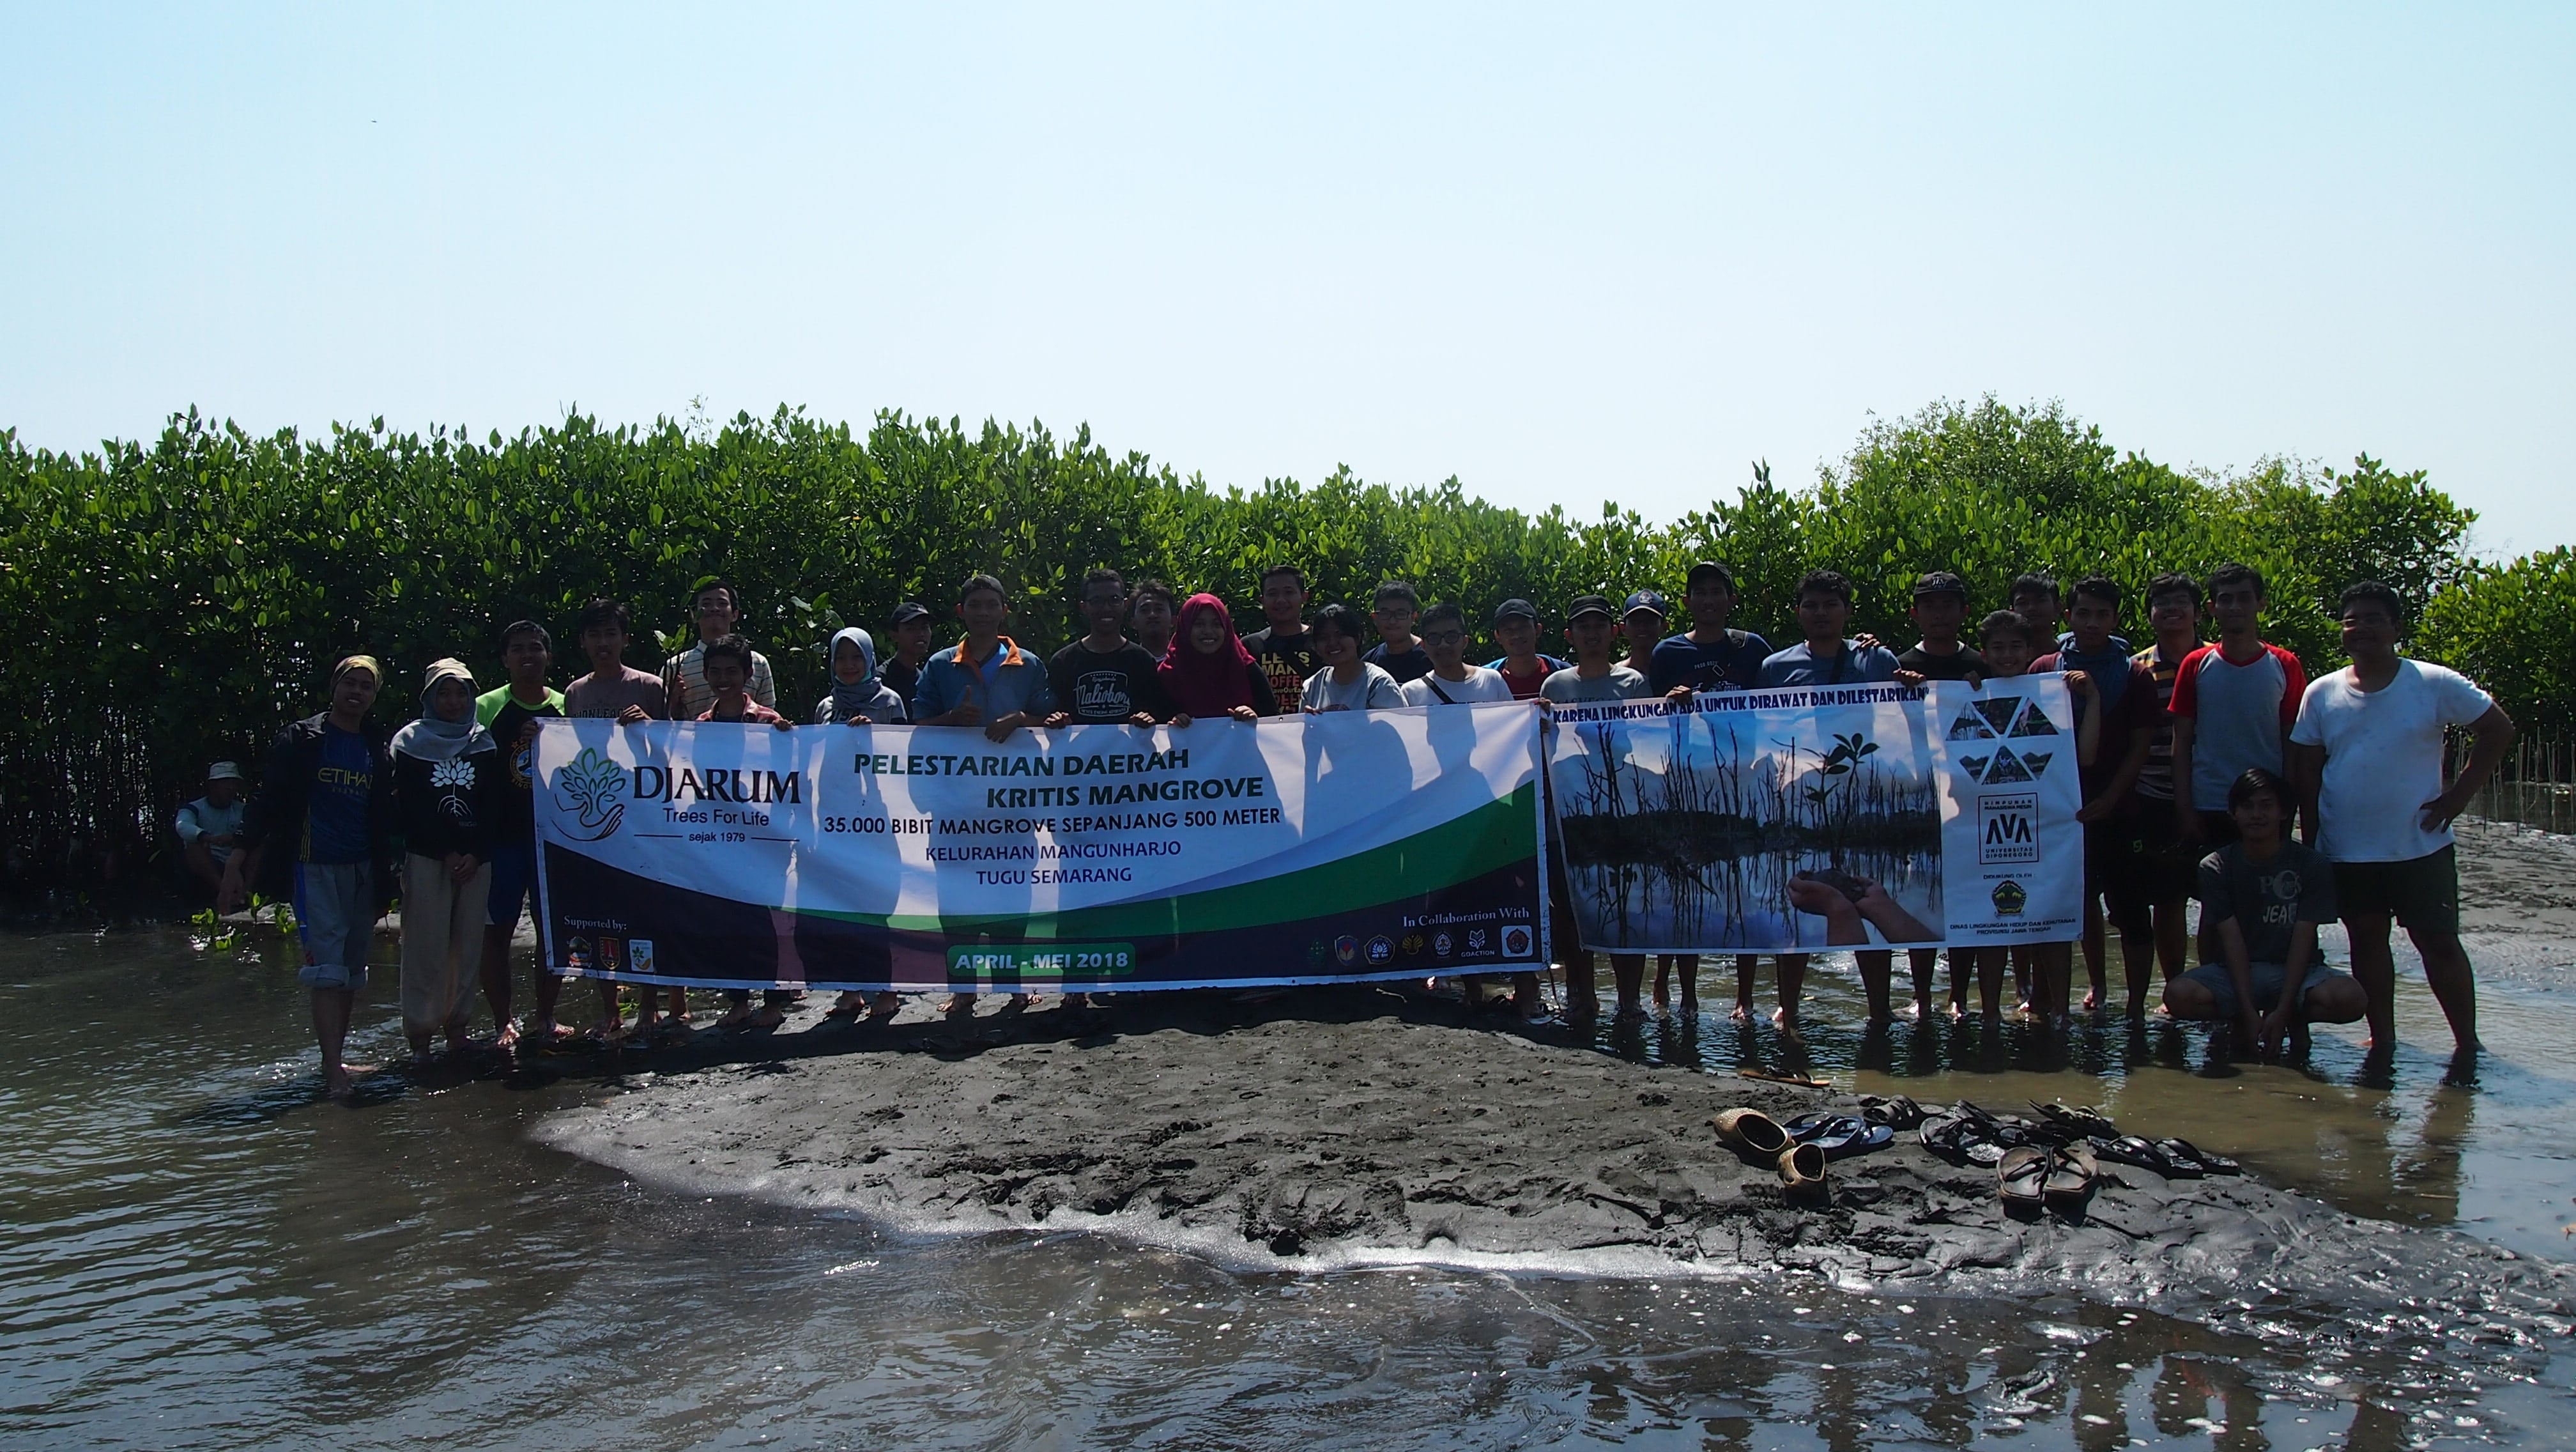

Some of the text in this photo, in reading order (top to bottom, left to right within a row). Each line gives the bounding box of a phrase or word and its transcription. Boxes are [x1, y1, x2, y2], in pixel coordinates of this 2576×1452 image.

[1602, 702, 1677, 720] LINGKUNGAN
[1705, 696, 1747, 712] UNTUK
[1749, 693, 1807, 709] DIRAWAT
[1811, 690, 1835, 706] DAN
[854, 749, 1188, 776] PELESTARIAN DAERAH
[634, 766, 801, 803] DJARUM
[987, 777, 1263, 808] KRITIS MANGROVE
[663, 808, 769, 826] Trees For Life
[824, 808, 1280, 834] 35.000 BIBIT MANGROVE SEPANJANG 500 METER
[689, 832, 745, 844] sejak 1979
[926, 841, 1181, 861] KELURAHAN MANGUNHARJO
[976, 868, 1132, 884] TUGU SEMARANG
[564, 915, 627, 932] Supported by:
[1403, 907, 1530, 927] In Collaboration With
[954, 954, 1017, 969] APRIL
[1033, 954, 1071, 969] MEI
[1077, 952, 1128, 968] 2018
[1460, 950, 1495, 958] GOACTION
